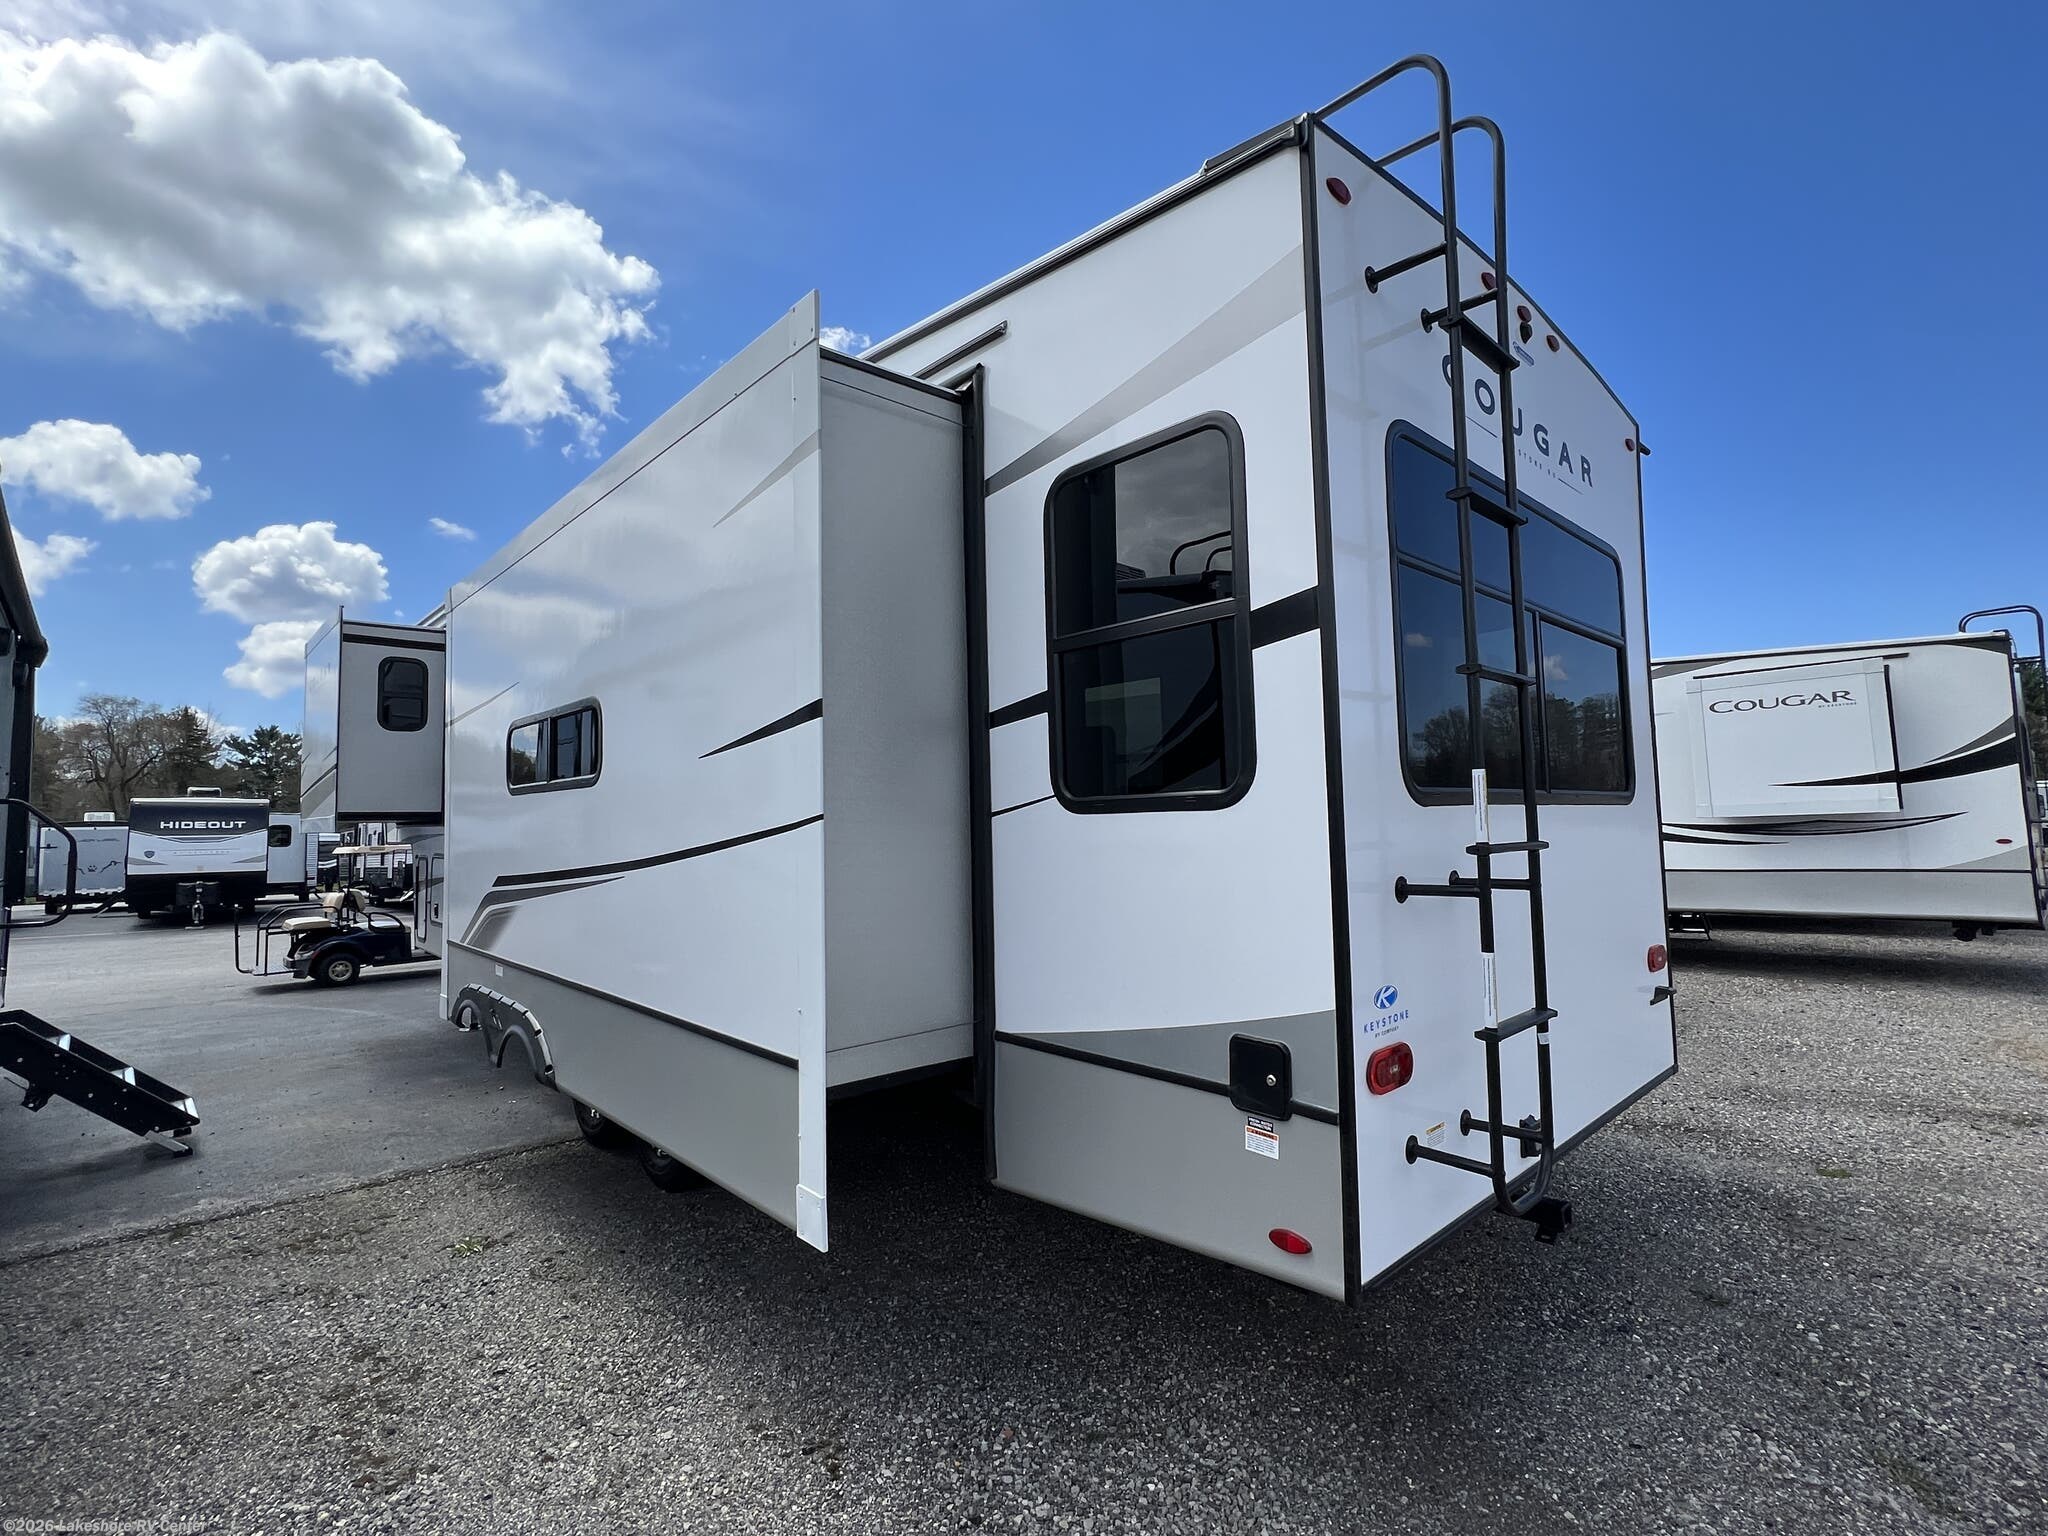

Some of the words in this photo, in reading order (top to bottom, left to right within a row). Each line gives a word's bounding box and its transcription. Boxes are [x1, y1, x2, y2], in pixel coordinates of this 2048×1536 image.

[1709, 690, 1856, 713] COUGAR
[160, 821, 246, 829] HIDEOUT
[1364, 1010, 1408, 1033] KEYSTONE
